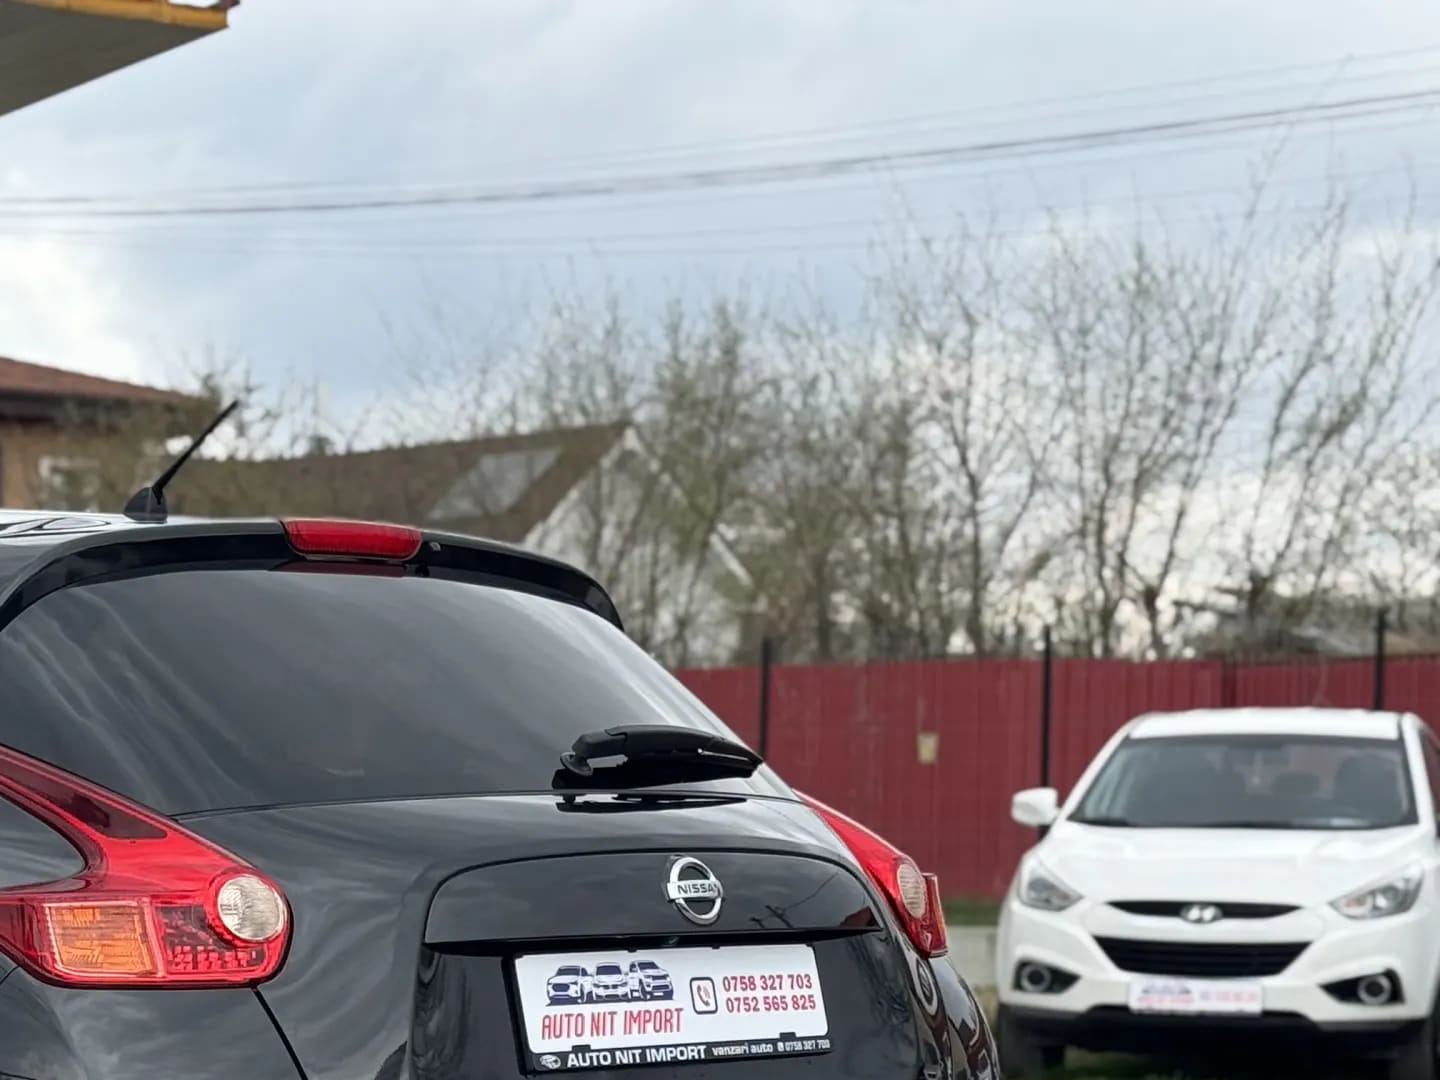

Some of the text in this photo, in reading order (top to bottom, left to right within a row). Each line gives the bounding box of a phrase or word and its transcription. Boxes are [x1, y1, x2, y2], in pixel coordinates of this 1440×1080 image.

[722, 973, 813, 992] 0758 327 703
[725, 994, 817, 1014] 0752 565 825
[541, 1007, 684, 1040] AUTO NIT IMPORT
[567, 1050, 611, 1068] AUTO
[615, 1049, 642, 1065] NIT
[646, 1045, 707, 1063] IMPORT
[750, 1042, 774, 1054] auto
